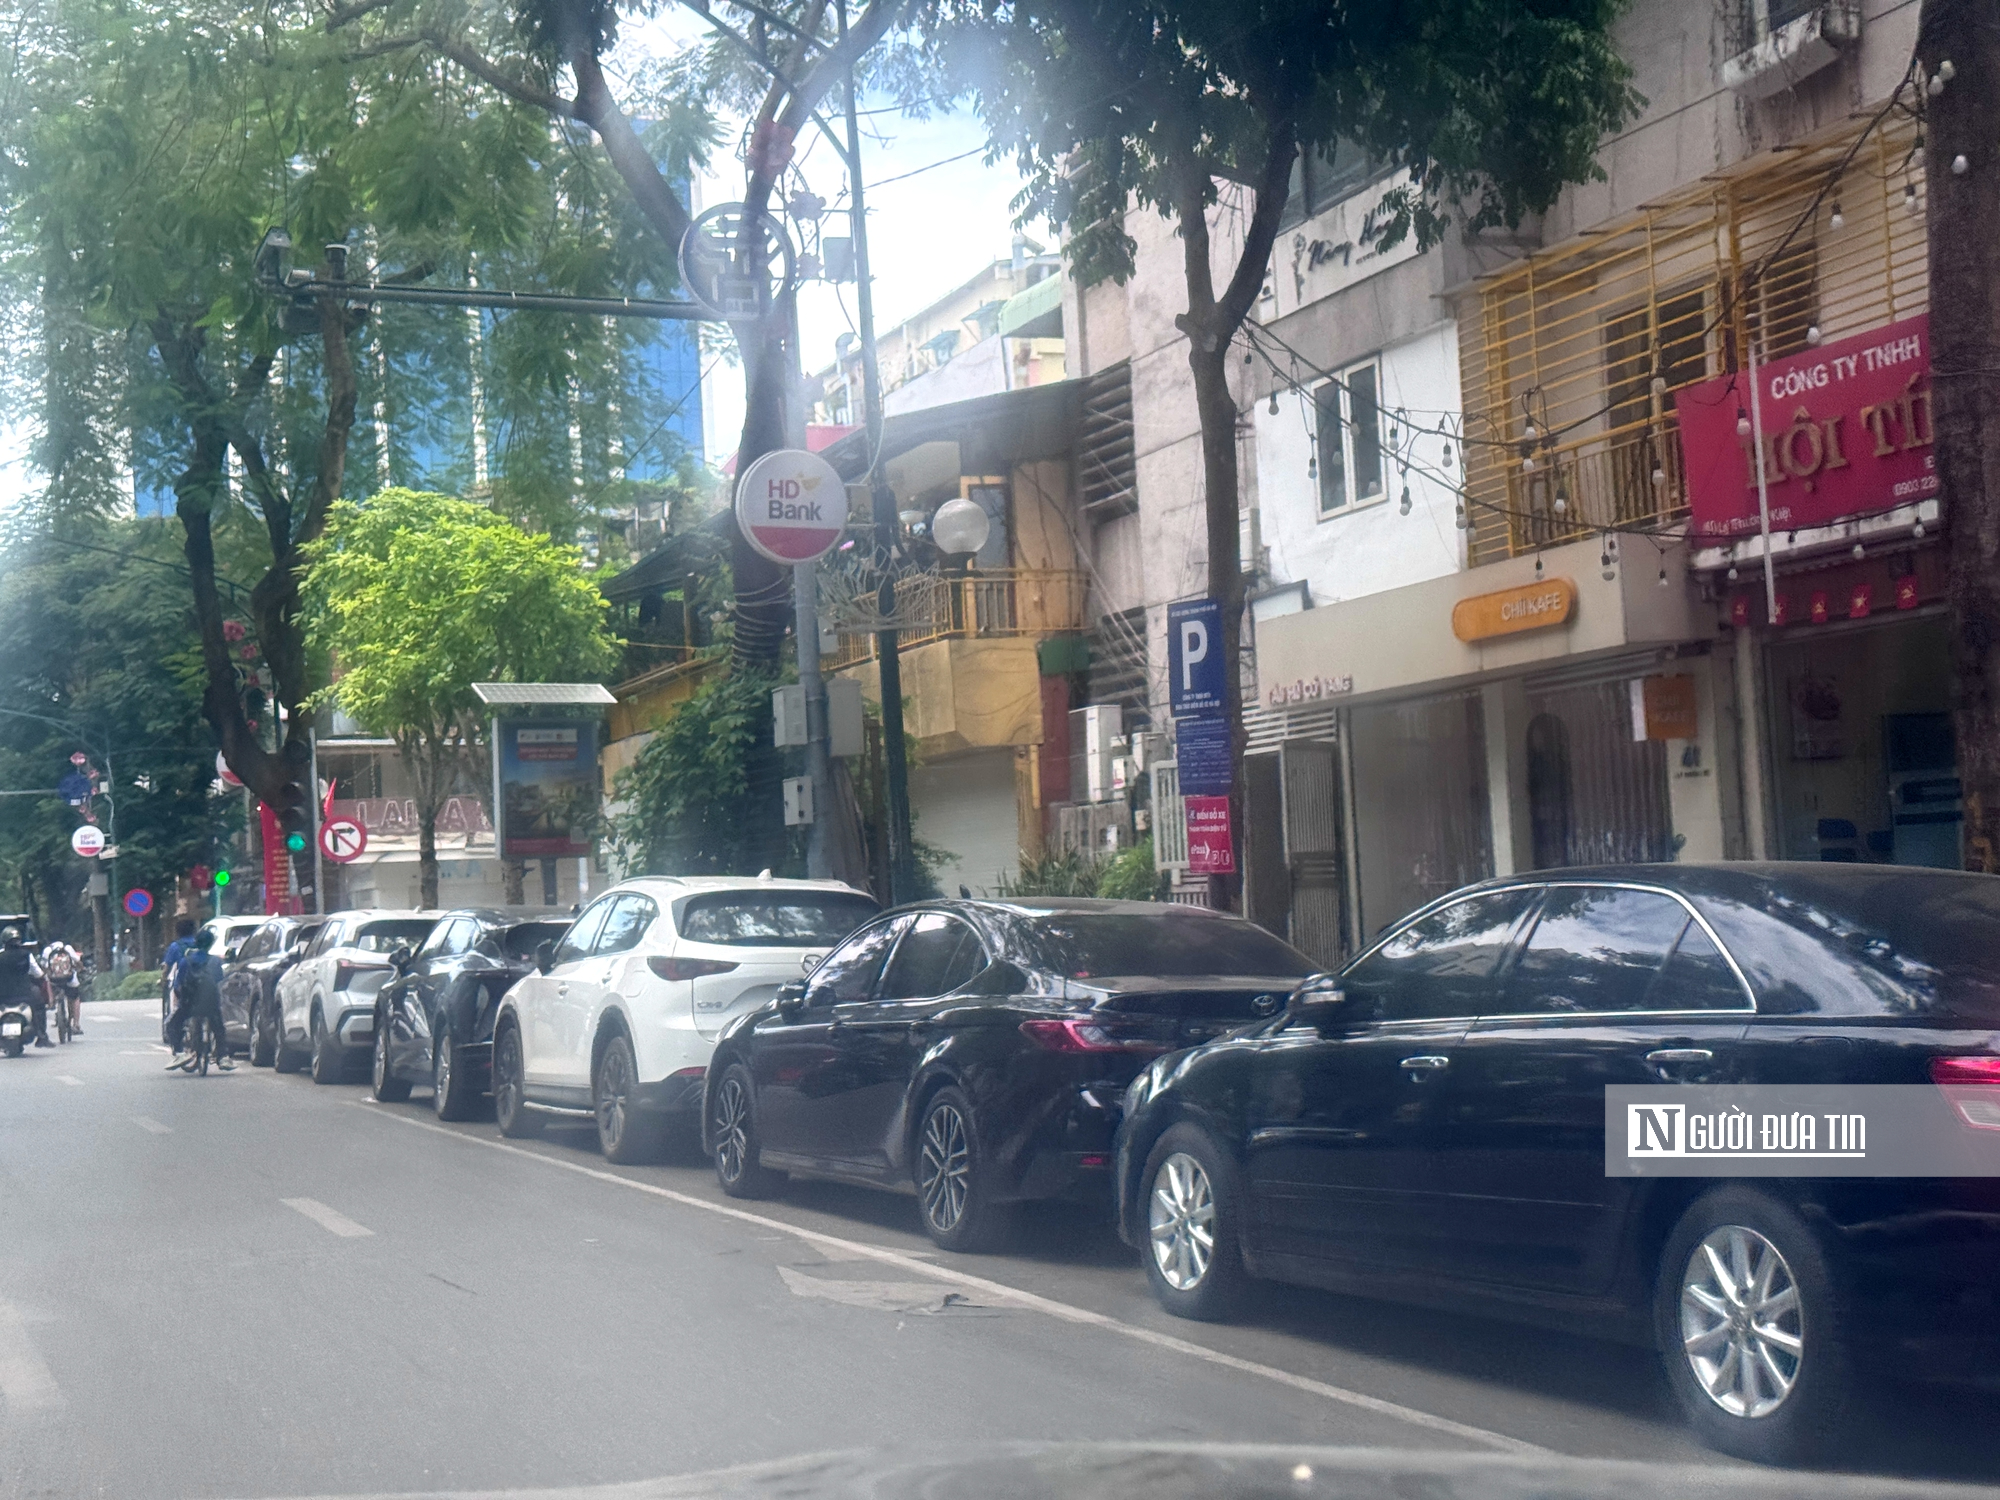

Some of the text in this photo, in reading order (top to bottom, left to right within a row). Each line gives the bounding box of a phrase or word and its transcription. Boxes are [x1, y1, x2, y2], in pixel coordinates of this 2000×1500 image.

[1771, 334, 1921, 400] CÔNG TY TNHH
[768, 479, 800, 499] HD
[768, 500, 822, 521] Bank
[1181, 620, 1208, 690] P
